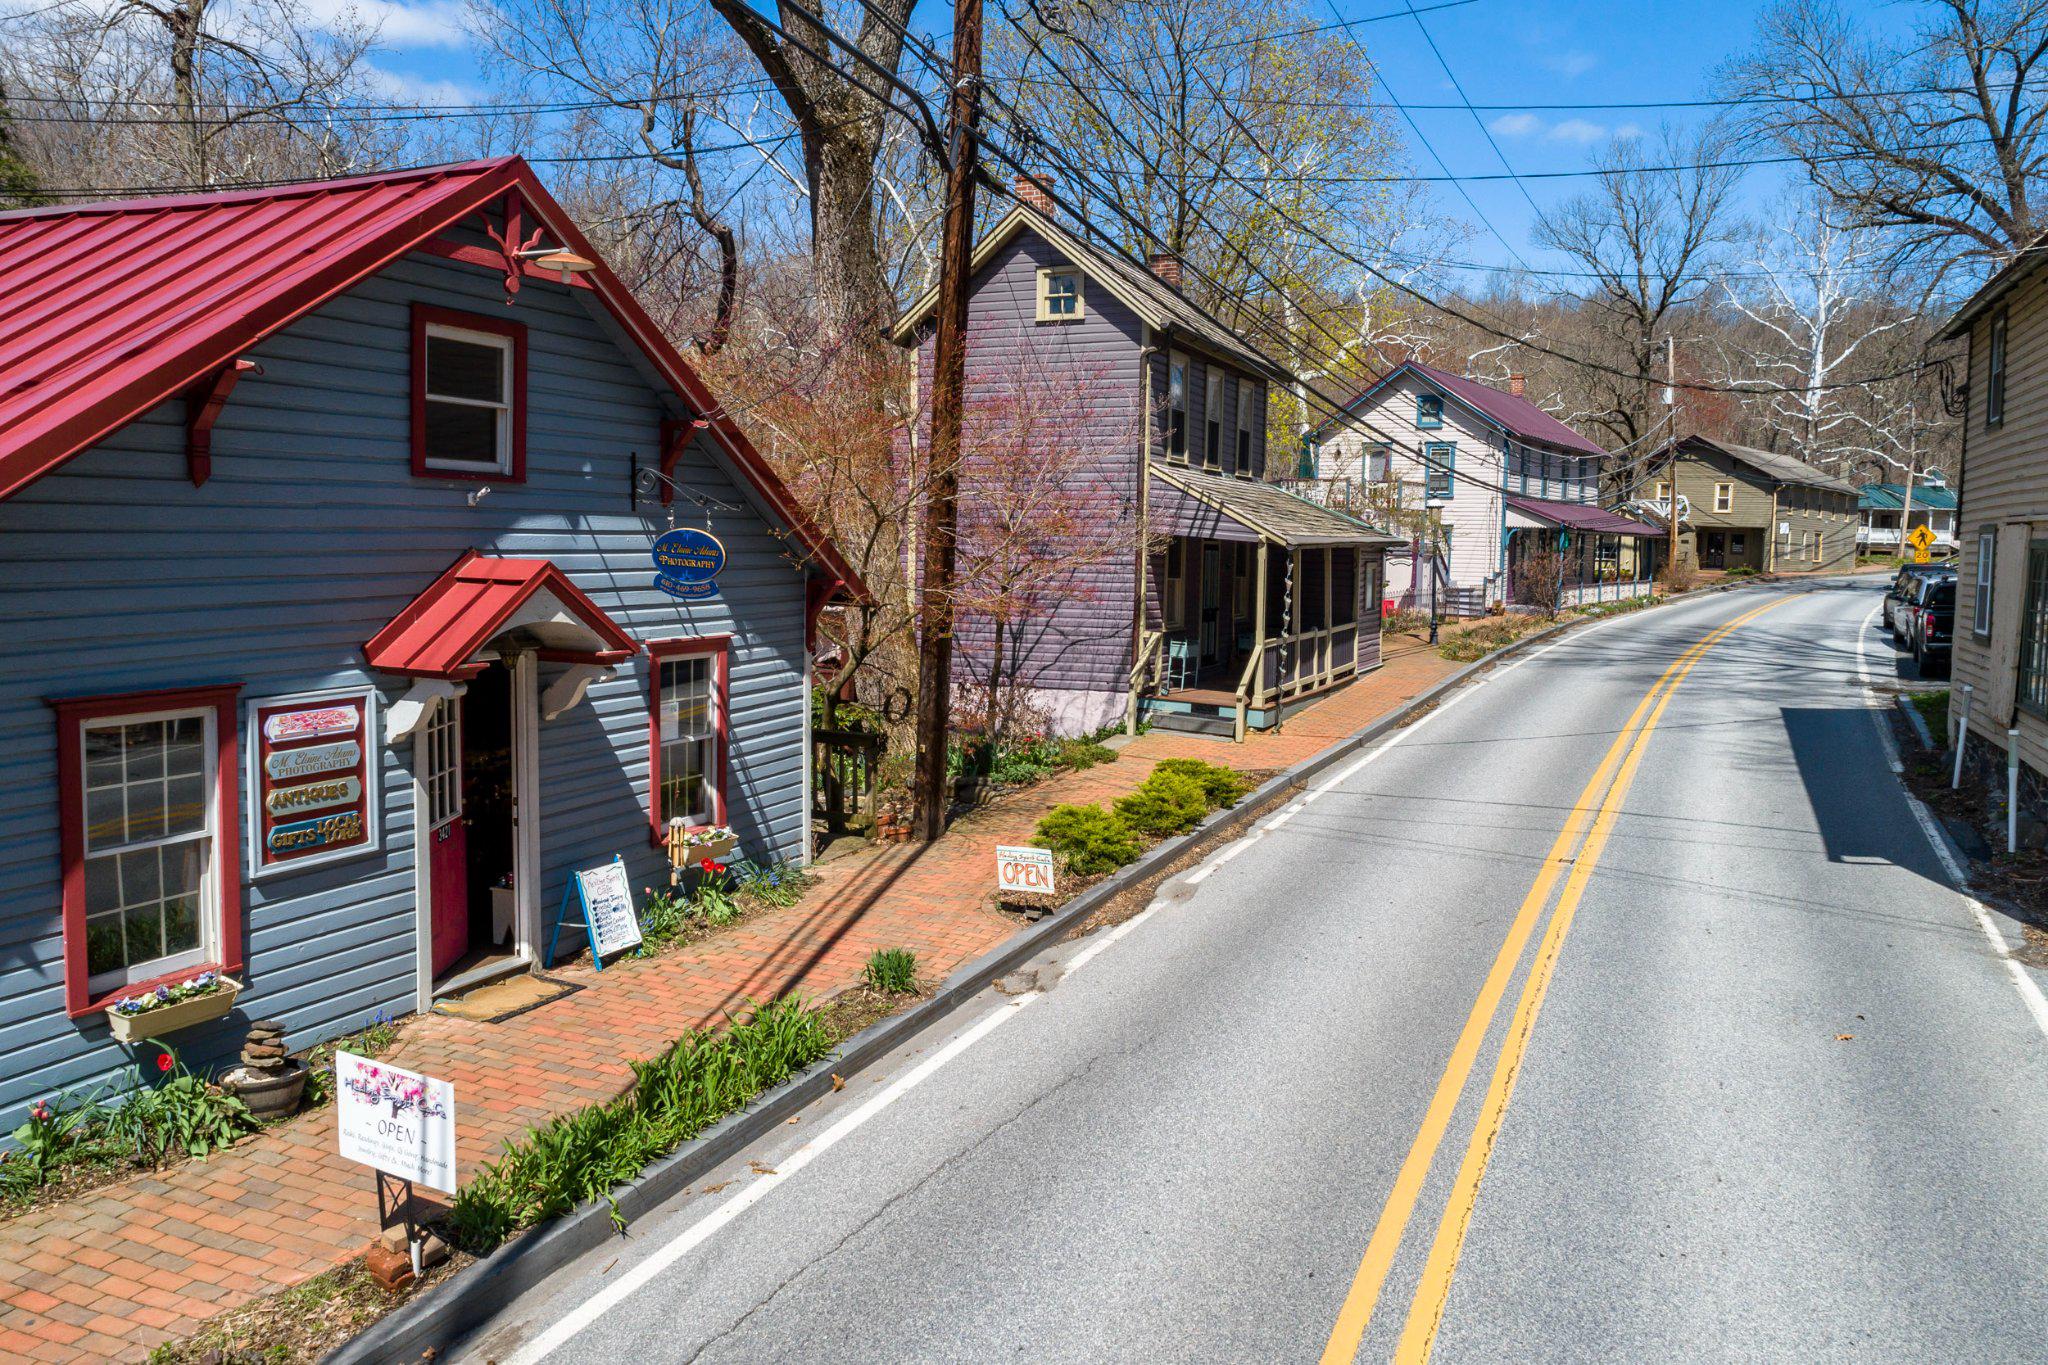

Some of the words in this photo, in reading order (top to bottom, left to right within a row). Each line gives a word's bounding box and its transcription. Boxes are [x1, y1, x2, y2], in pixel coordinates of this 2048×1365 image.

[671, 542, 692, 555] Elaine
[694, 546, 719, 556] Adams
[659, 555, 715, 568] PHOTOGRAPHY
[294, 750, 322, 766] Elaine
[323, 746, 357, 761] Adams
[278, 757, 353, 777] PHOTOGRAPHY
[271, 782, 349, 810] ANTIQUES
[316, 813, 362, 834] LOCAL
[271, 828, 318, 848] GIFTS
[324, 825, 361, 844] LORE
[1003, 862, 1049, 887] OPEN
[345, 1078, 380, 1105] Healing
[378, 1119, 415, 1144] OPEN
